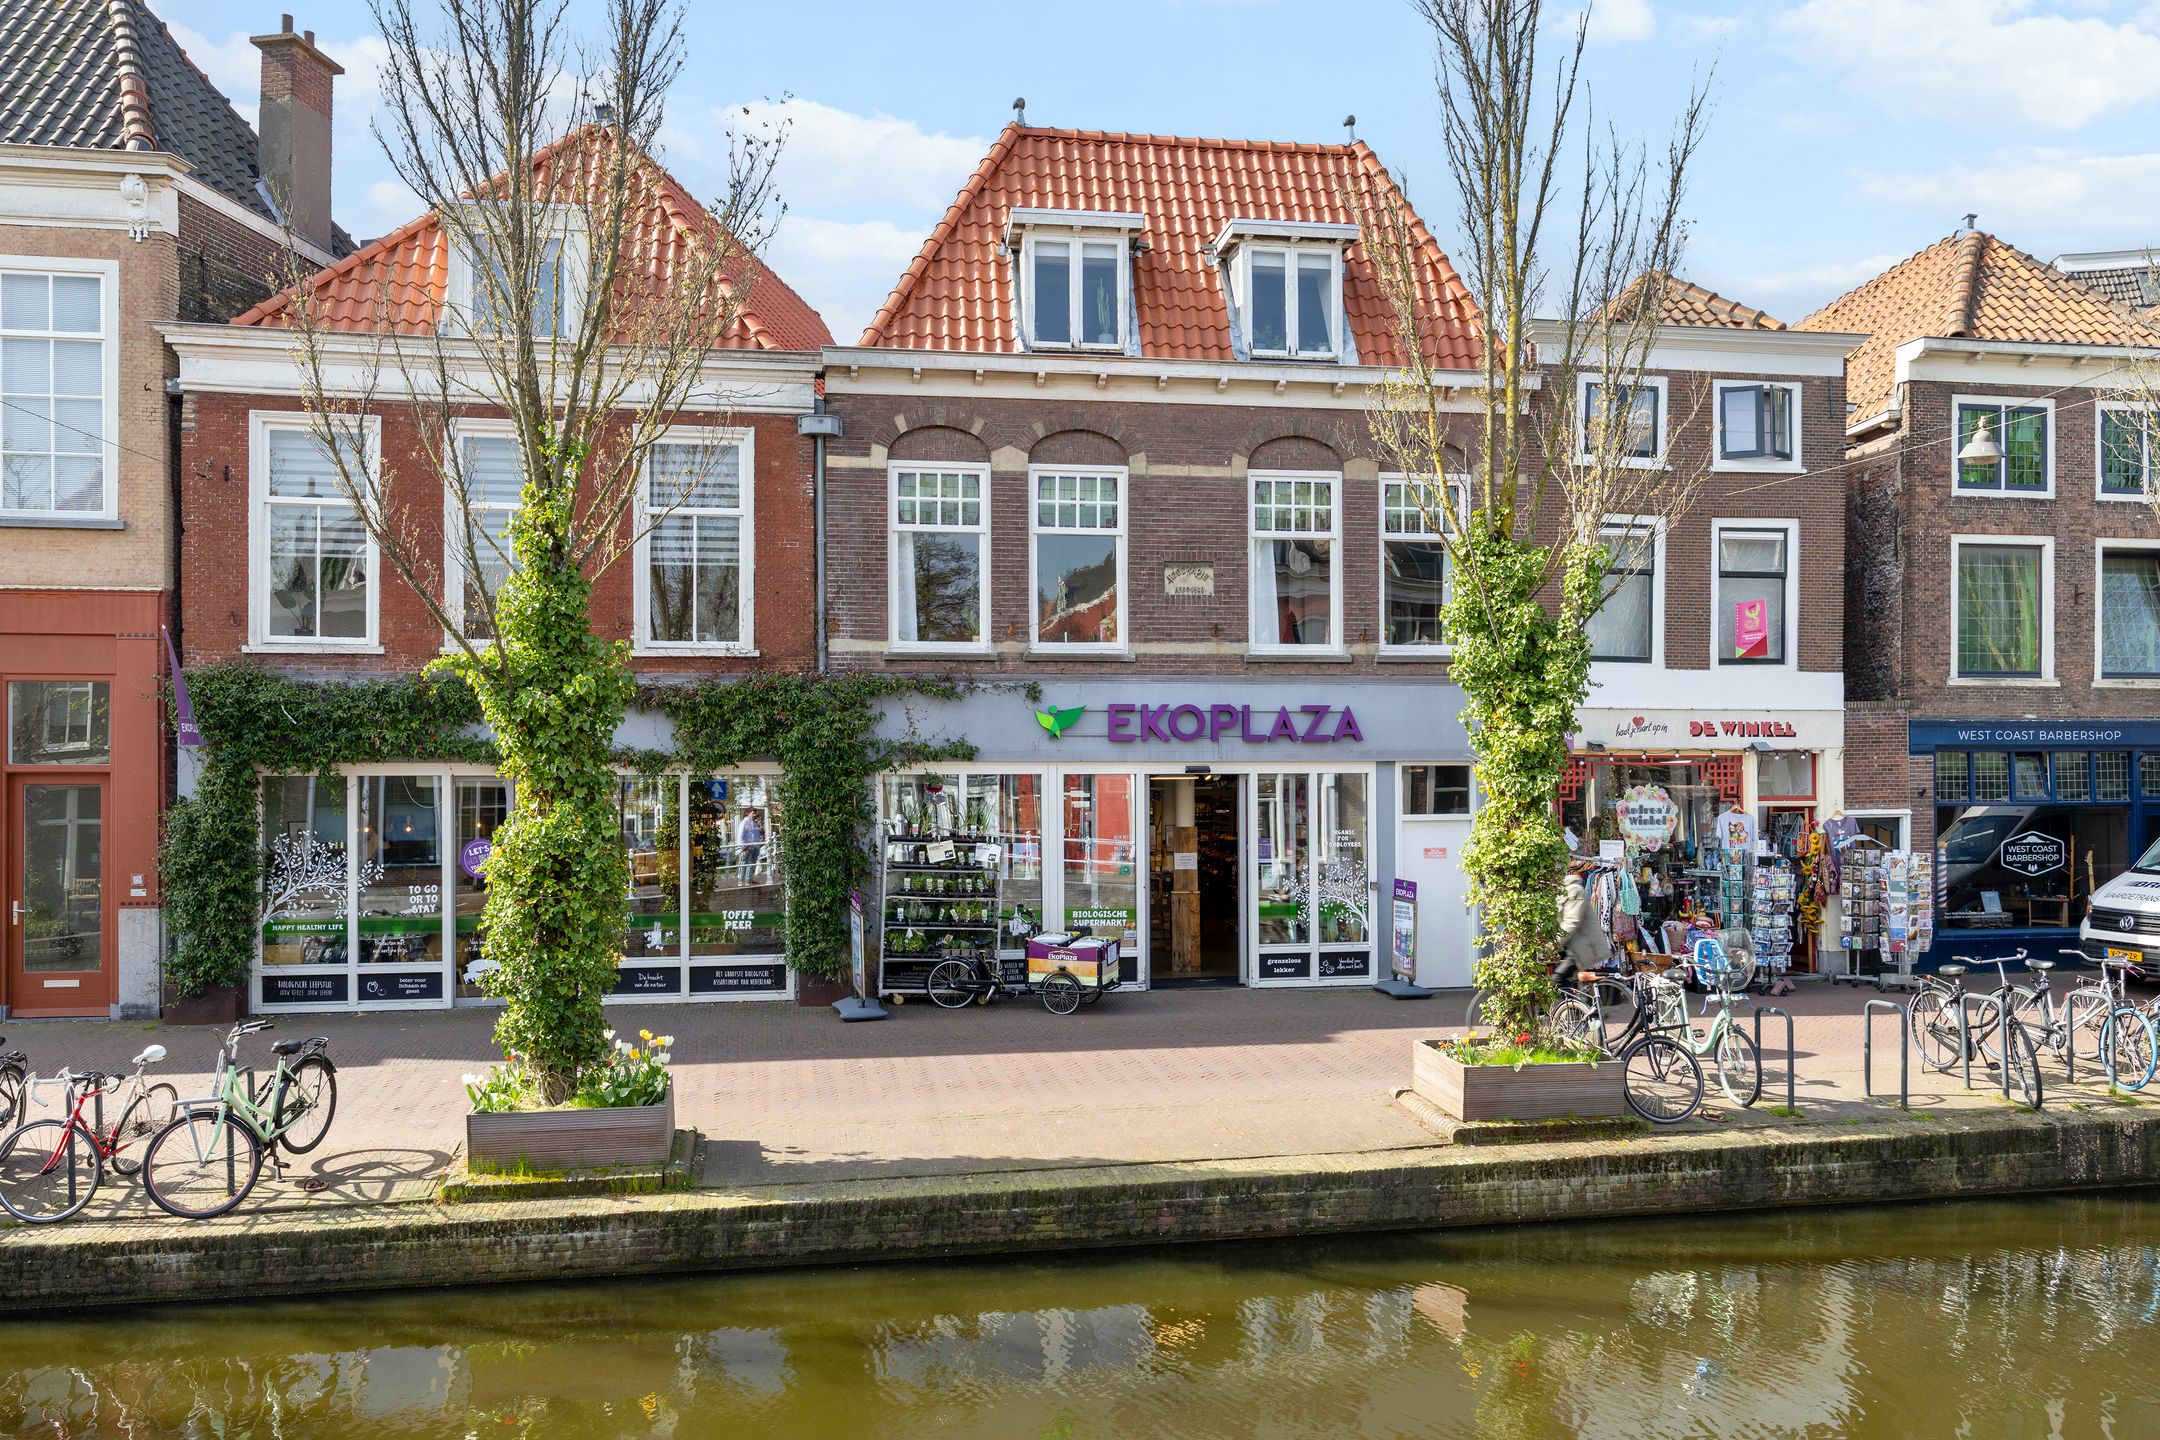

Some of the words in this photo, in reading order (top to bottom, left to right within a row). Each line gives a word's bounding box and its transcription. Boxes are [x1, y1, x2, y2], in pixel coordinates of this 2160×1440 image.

[1107, 703, 1365, 743] EKOPLAZA
[1690, 721, 1717, 737] DE
[1720, 721, 1796, 737] WINKEL
[1958, 730, 1992, 741] WEST
[1995, 730, 2035, 741] COAST
[2039, 730, 2122, 741] BARBERSHOP
[1629, 815, 1667, 826] Winkel
[468, 845, 490, 856] LET'S
[2007, 845, 2030, 853] WEST
[2031, 845, 2057, 853] COAST
[2006, 854, 2060, 862] BARBERSHOP
[409, 885, 421, 894] TO
[424, 885, 438, 893] GO
[409, 895, 422, 904] OR
[425, 895, 438, 903] TO
[411, 904, 436, 914] STAY
[722, 910, 755, 920] TOFFE
[1072, 910, 1128, 919] BIOLOGISCHE
[724, 920, 752, 930] PEER
[1073, 919, 1127, 927] SUPERMARKT
[1048, 953, 1077, 961] EkoPlaza
[278, 980, 308, 989] BIOLOGISCHE
